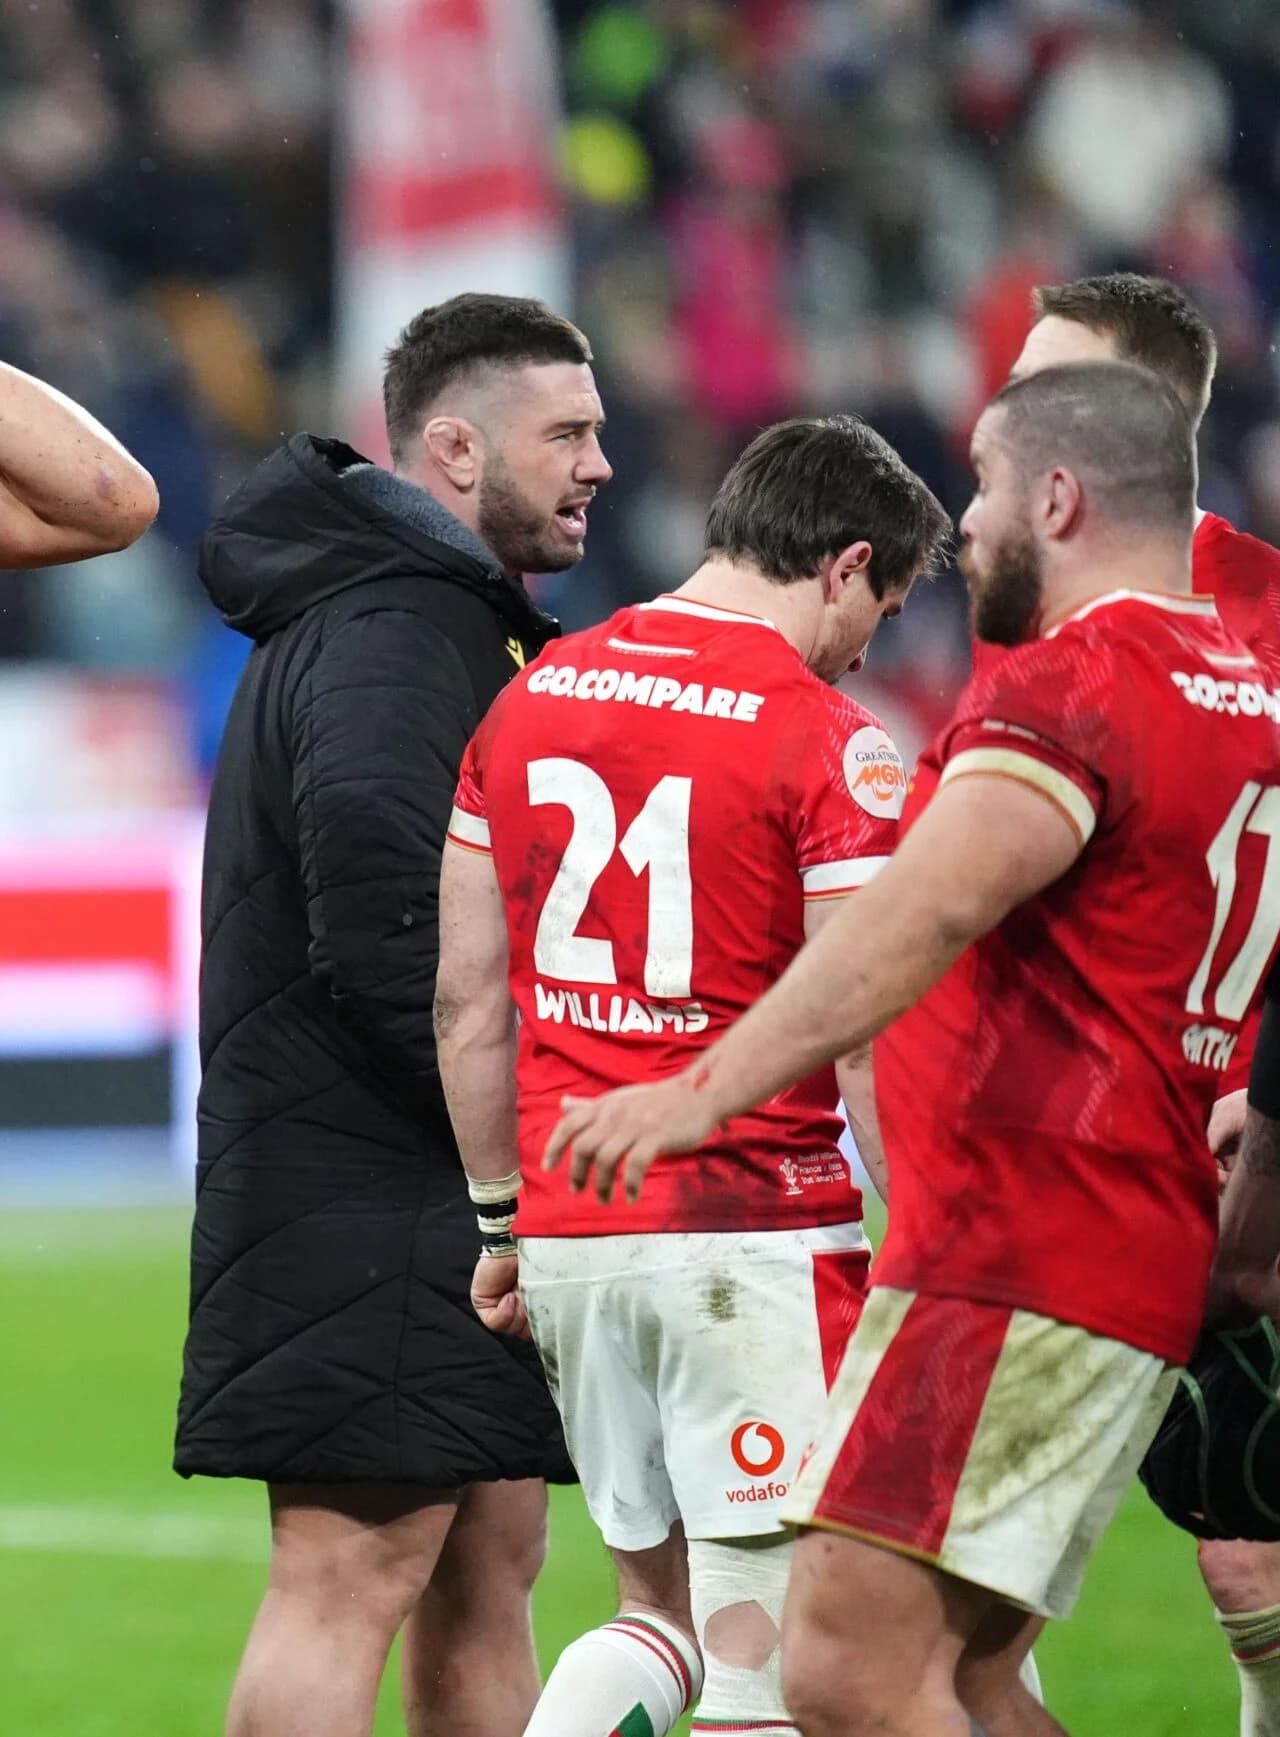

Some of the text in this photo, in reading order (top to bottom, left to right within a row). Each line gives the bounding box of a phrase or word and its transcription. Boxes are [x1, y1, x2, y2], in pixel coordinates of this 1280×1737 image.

[526, 664, 766, 723] GO.COMPARE
[526, 757, 693, 999] 21
[1185, 779, 1280, 1023] 17
[534, 982, 710, 1035] WILLIAMS
[725, 1481, 791, 1503] vodafo
